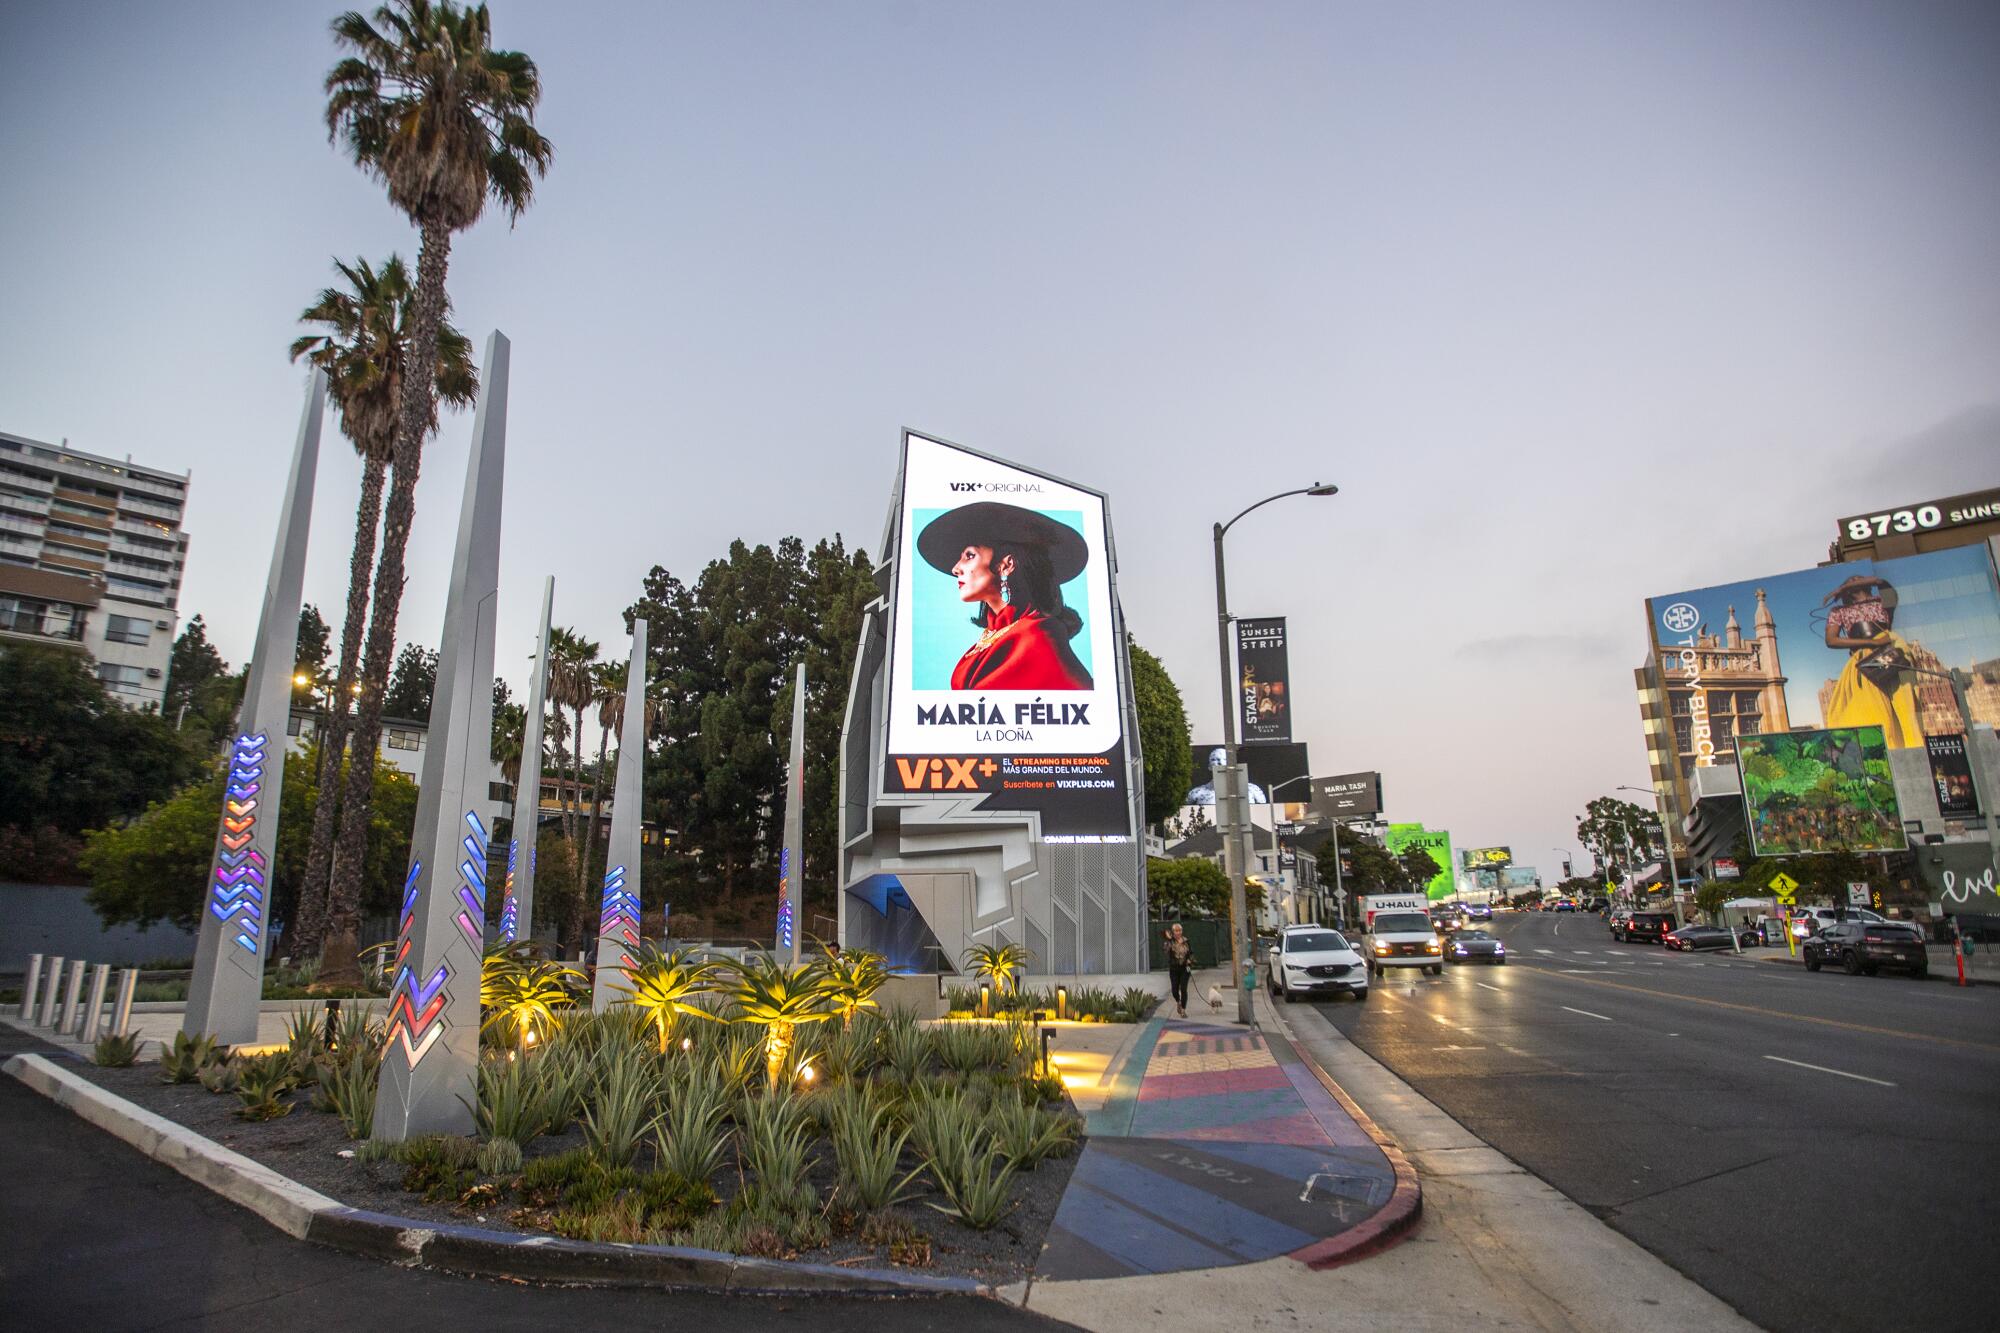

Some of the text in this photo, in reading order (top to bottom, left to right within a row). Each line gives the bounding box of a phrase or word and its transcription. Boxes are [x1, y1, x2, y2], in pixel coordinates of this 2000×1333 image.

[984, 482, 1045, 493] ORIGINAL
[1847, 505, 1942, 541] 8730
[1241, 627, 1283, 637] SUNSET
[1241, 639, 1284, 650] STRIP
[1245, 686, 1258, 724] STARZ
[1678, 635, 1718, 768] TORY BURCH
[917, 696, 1091, 726] MARÍA FÉLIX
[976, 727, 1034, 742] LA DOÑA
[1002, 756, 1110, 766] EL STREAMING EN ESPAÑOL
[1002, 765, 1103, 774] MÁS GRANDE DEL MUNDO.
[1003, 780, 1115, 789] Suscríbete en VIXPLUS.COM
[1324, 784, 1348, 794] MARIA
[1348, 781, 1367, 791] TASH
